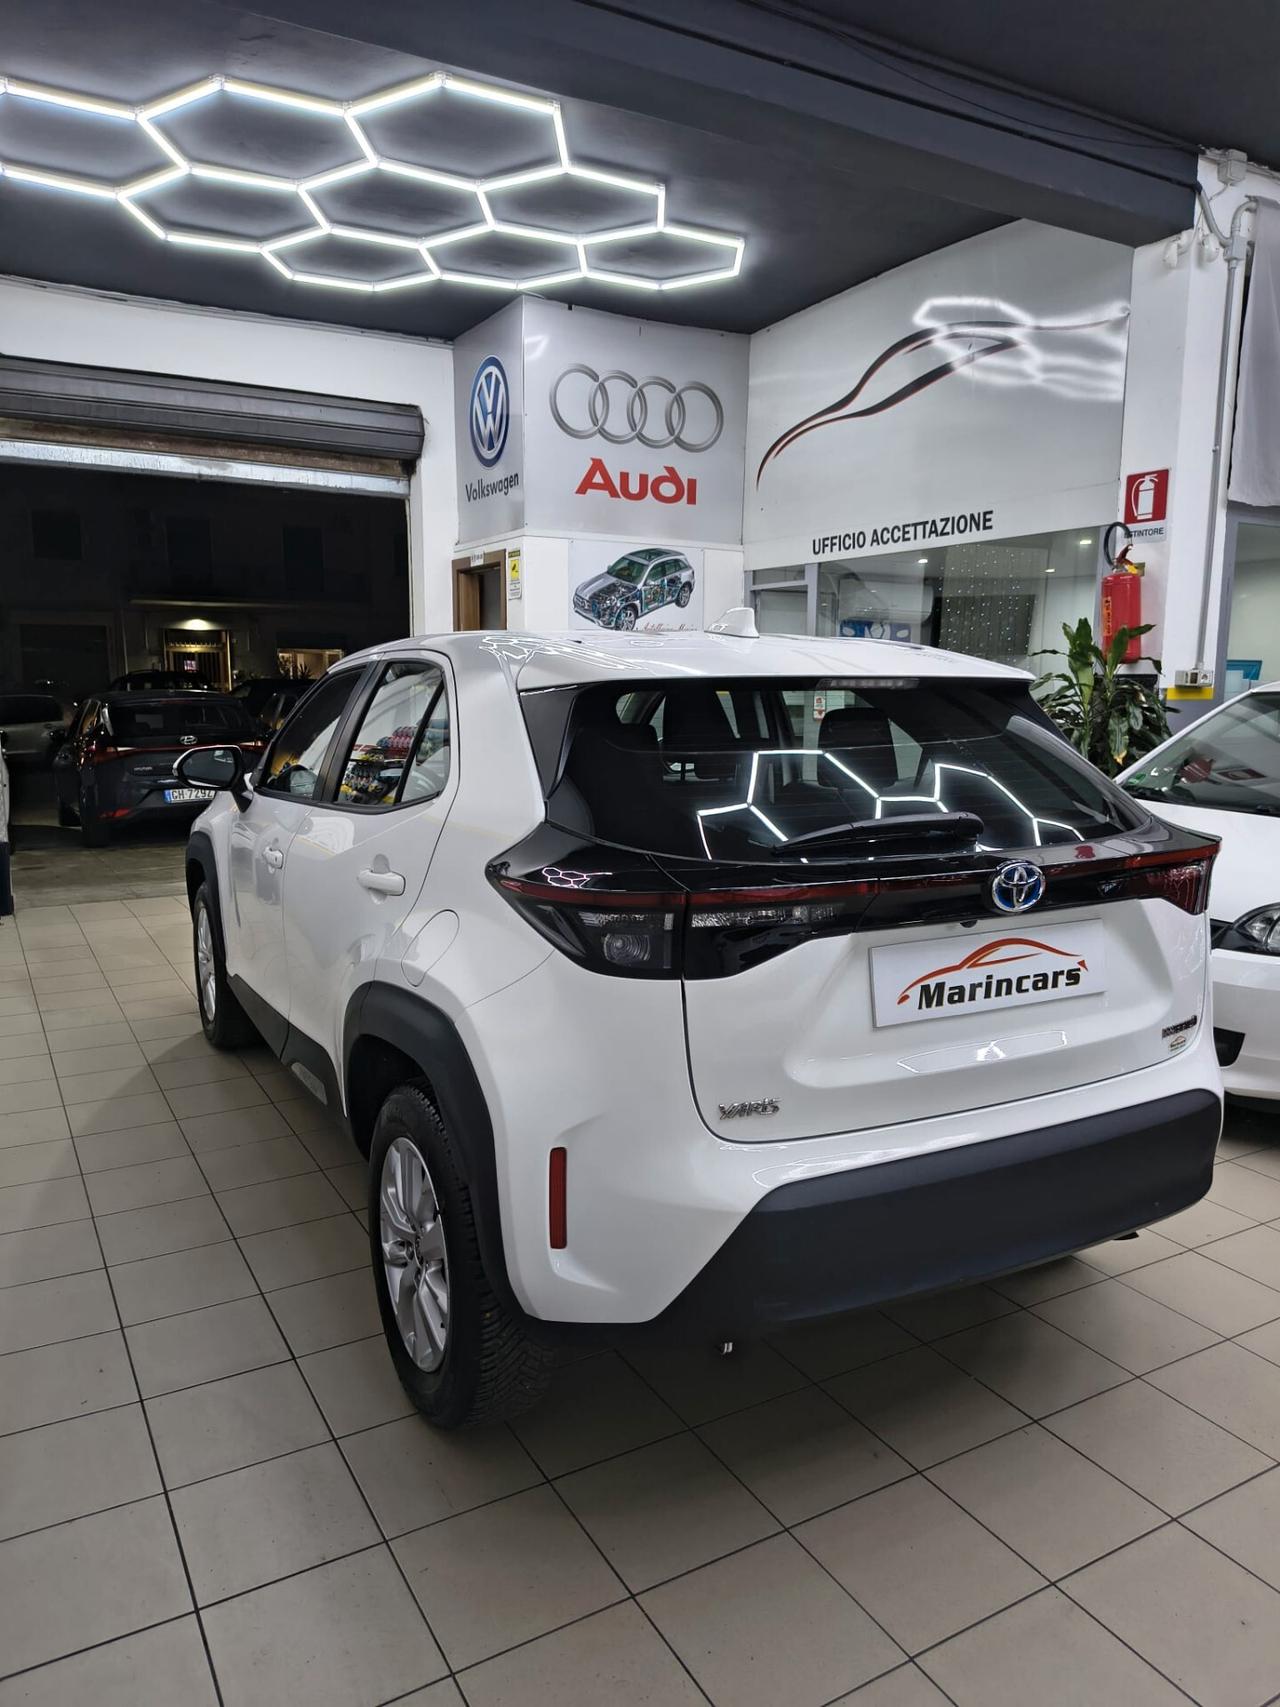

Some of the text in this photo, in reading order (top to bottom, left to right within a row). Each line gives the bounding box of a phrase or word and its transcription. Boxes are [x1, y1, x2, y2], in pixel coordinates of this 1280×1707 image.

[465, 473, 519, 502] Volkswagen
[575, 457, 697, 505] Audi
[812, 510, 993, 555] UFFICIO ACCETTAZIONE
[918, 967, 1081, 1010] Marincars
